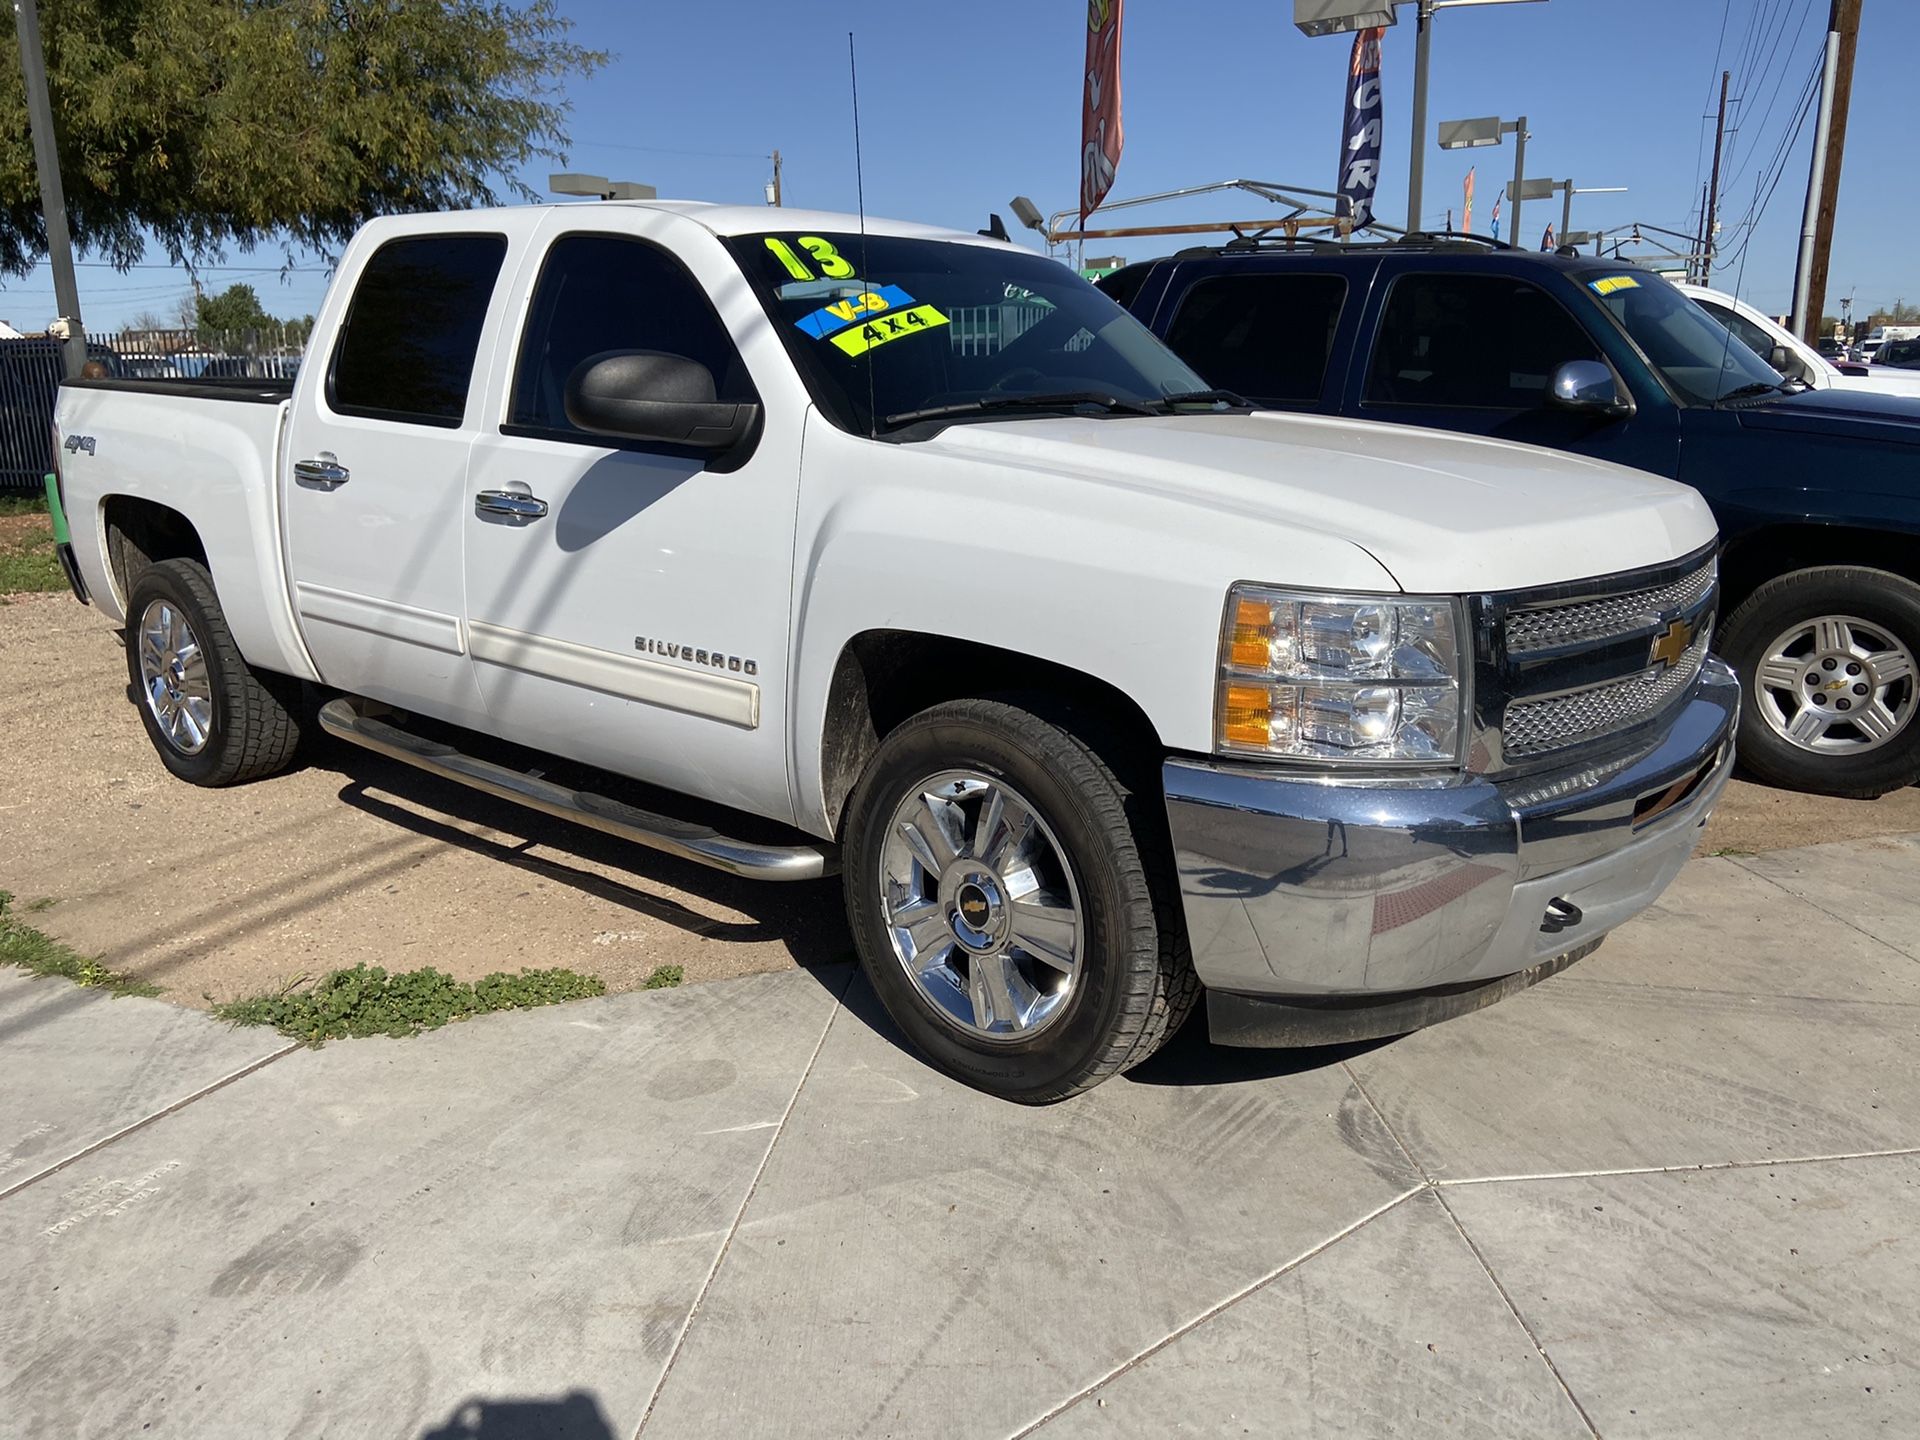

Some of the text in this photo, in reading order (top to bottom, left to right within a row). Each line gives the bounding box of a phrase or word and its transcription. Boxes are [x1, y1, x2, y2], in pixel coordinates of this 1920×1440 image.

[764, 236, 855, 281] 13
[825, 292, 889, 321] V-8
[634, 636, 758, 675] SILVERADO
